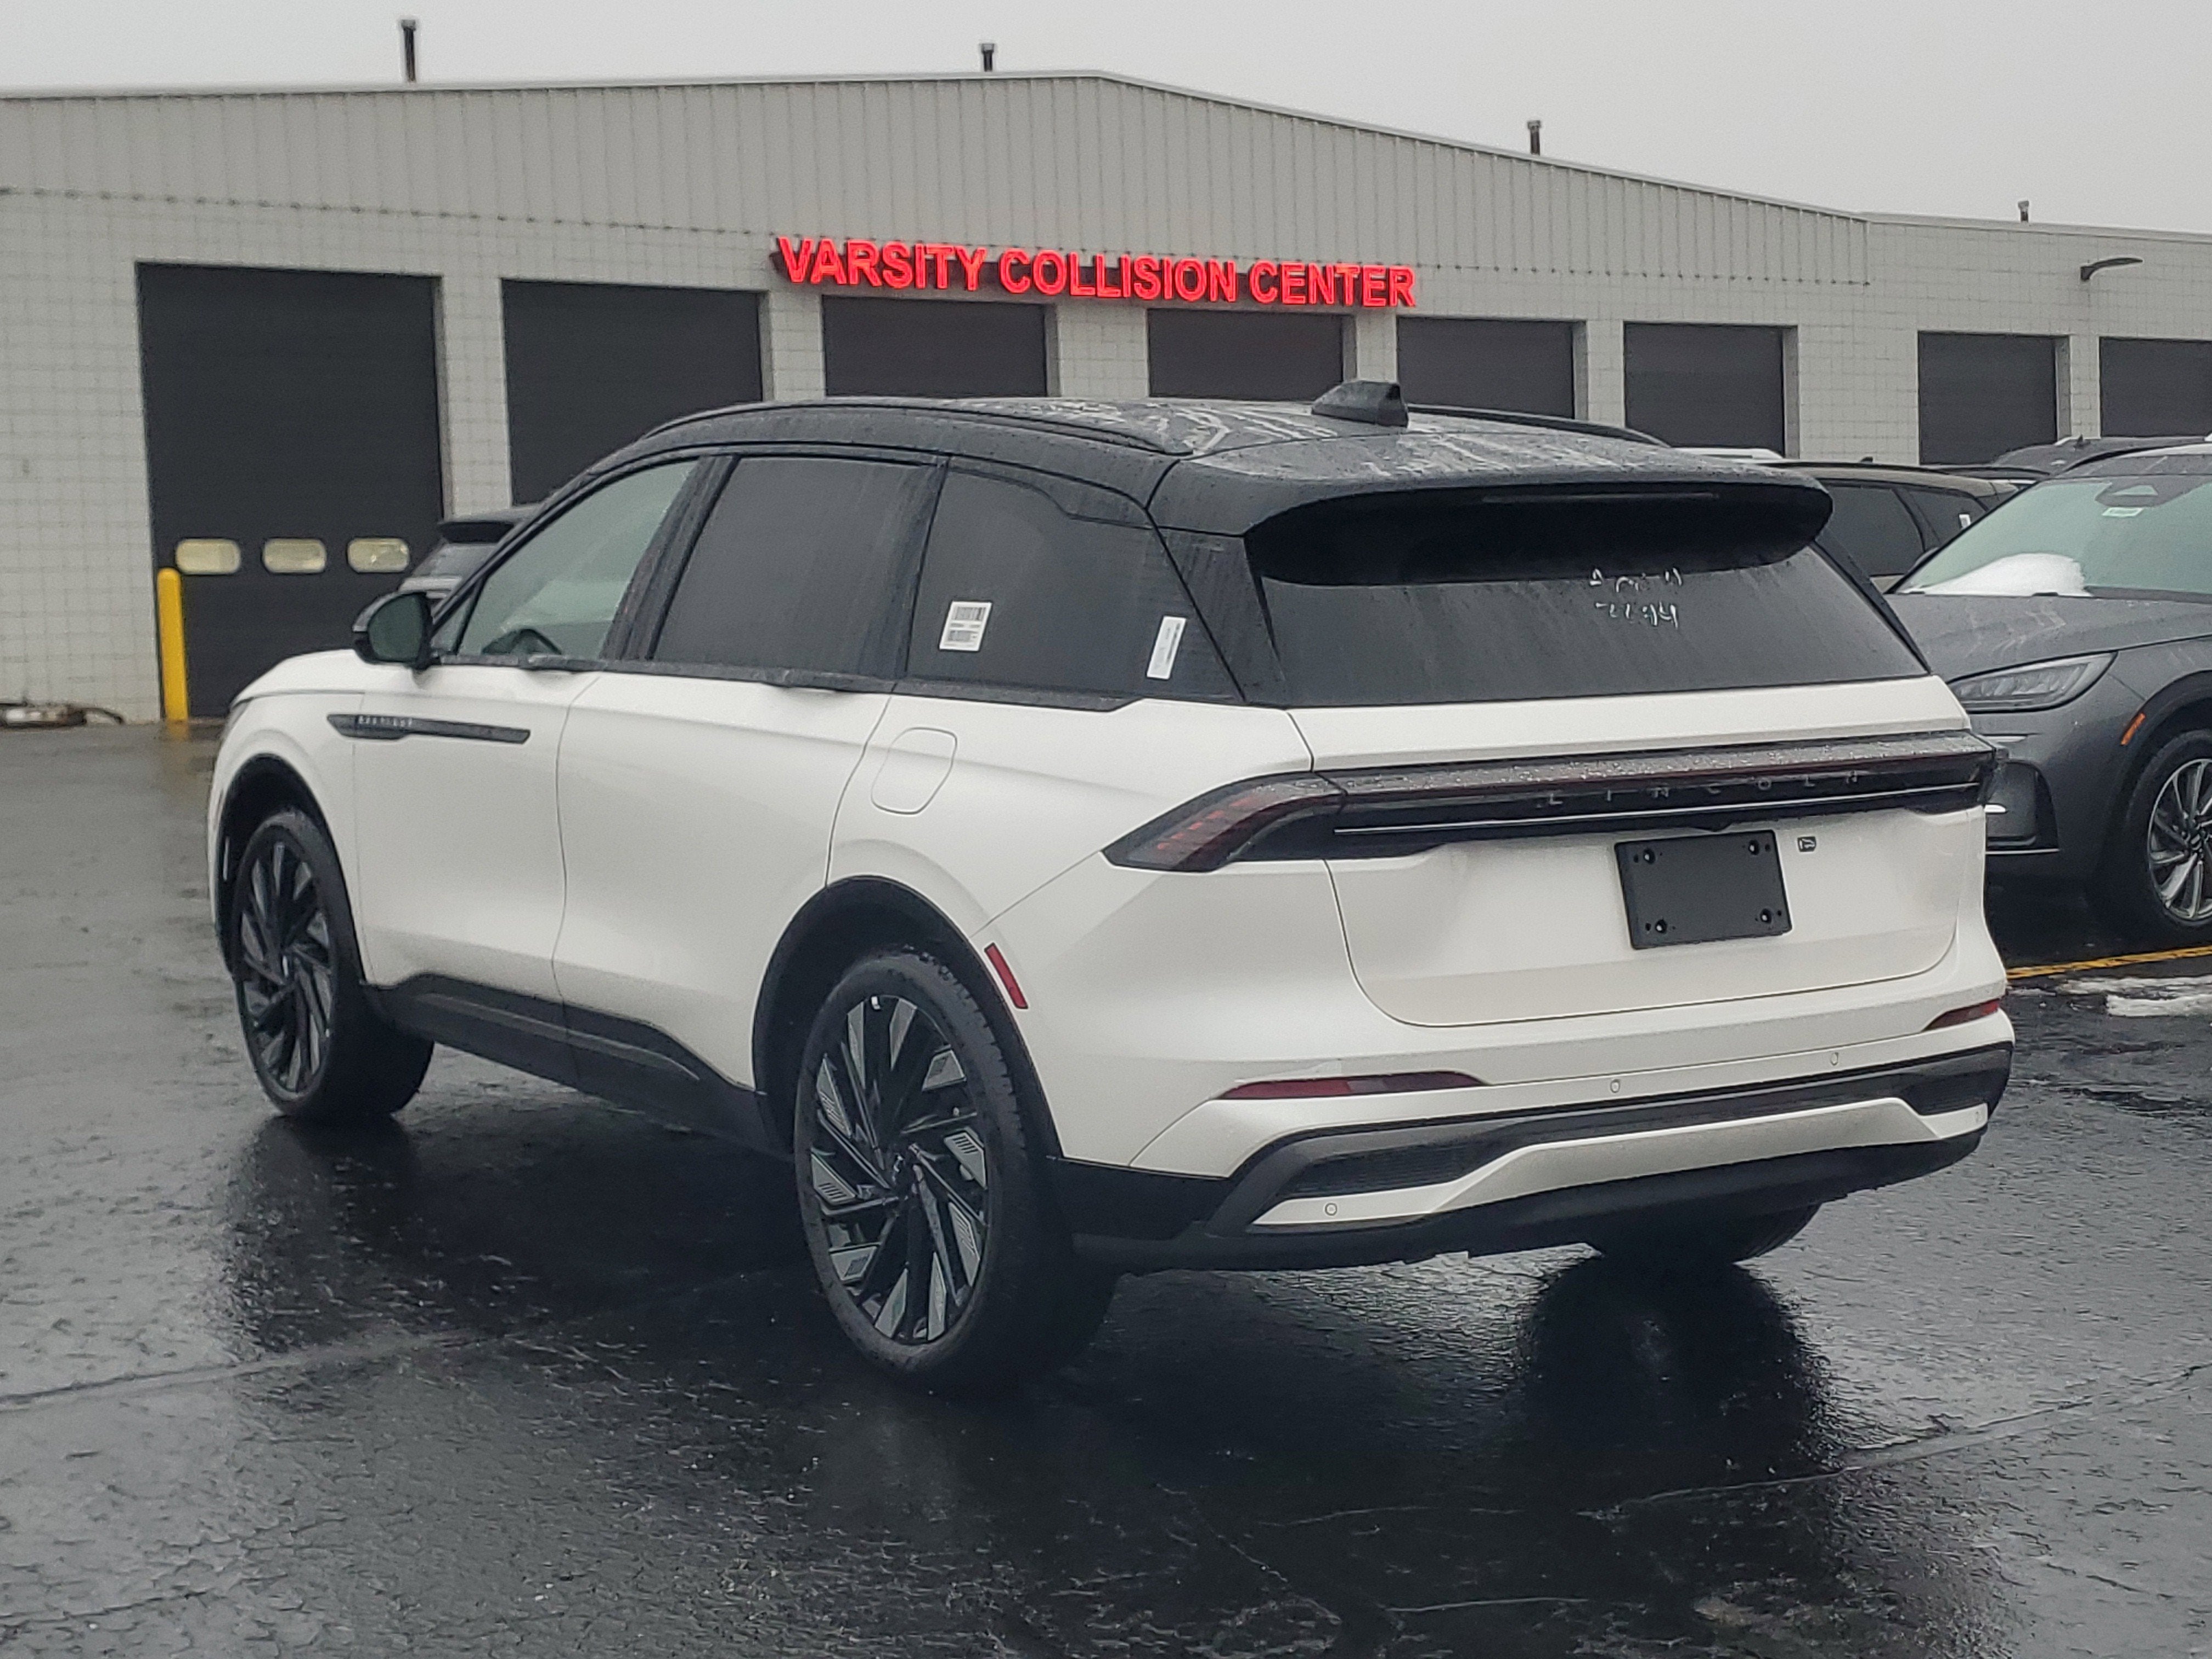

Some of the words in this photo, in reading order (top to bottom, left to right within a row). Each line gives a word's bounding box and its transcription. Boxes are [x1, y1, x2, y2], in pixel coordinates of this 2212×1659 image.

[778, 237, 988, 291] VARSITY
[998, 248, 1238, 302] COLLISION
[1248, 260, 1416, 307] CENTER
